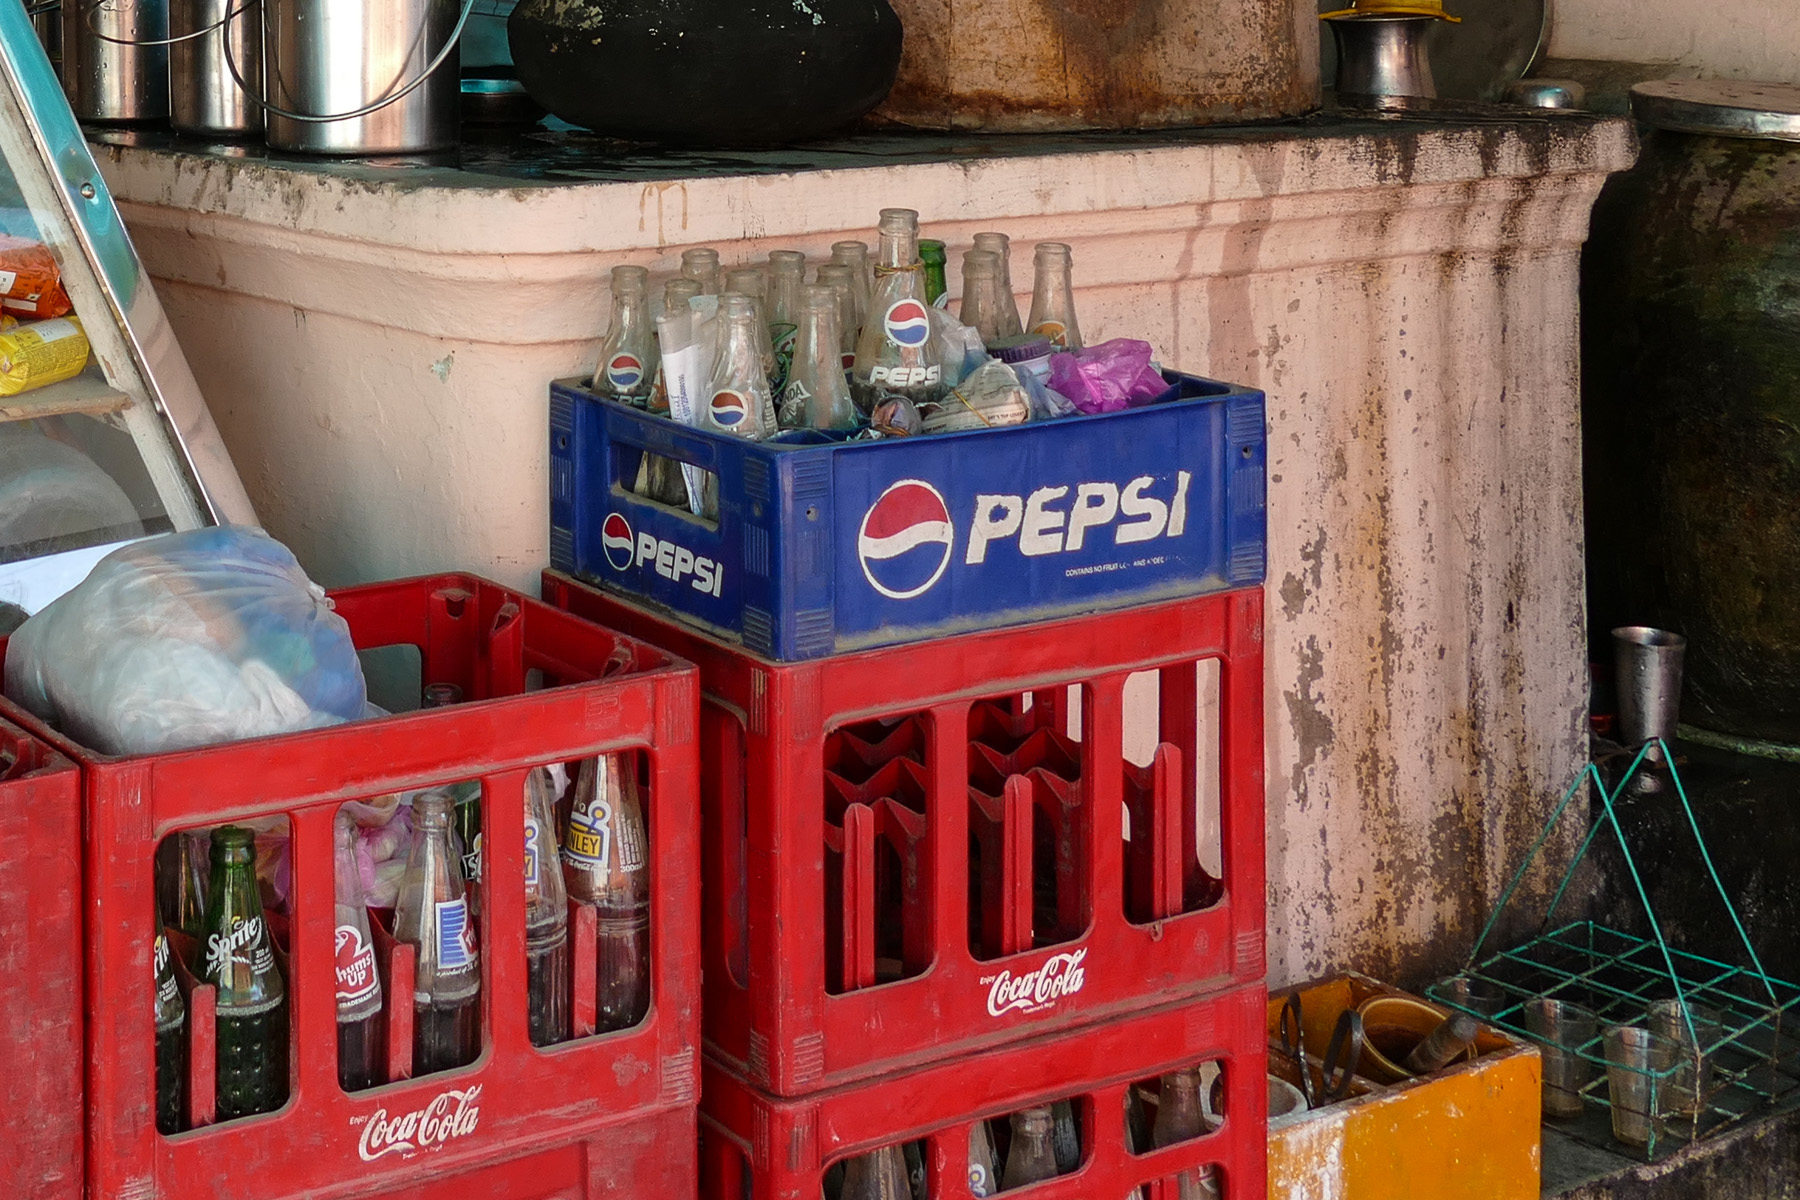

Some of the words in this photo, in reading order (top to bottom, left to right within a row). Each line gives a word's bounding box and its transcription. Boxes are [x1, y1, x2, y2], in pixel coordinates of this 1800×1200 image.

[966, 471, 1191, 566] PEPSI
[635, 531, 724, 598] PEPSI
[1065, 566, 1093, 577] CONTAINS
[1093, 564, 1103, 573] NO
[1102, 563, 1119, 572] FRUIT
[205, 915, 261, 963] Sprite
[336, 952, 373, 985] hums
[979, 974, 996, 986] Enjoy
[986, 946, 1089, 1018] Coca-Cola
[349, 1114, 369, 1126] Enjoy
[358, 1083, 483, 1162] Coca-Cola
